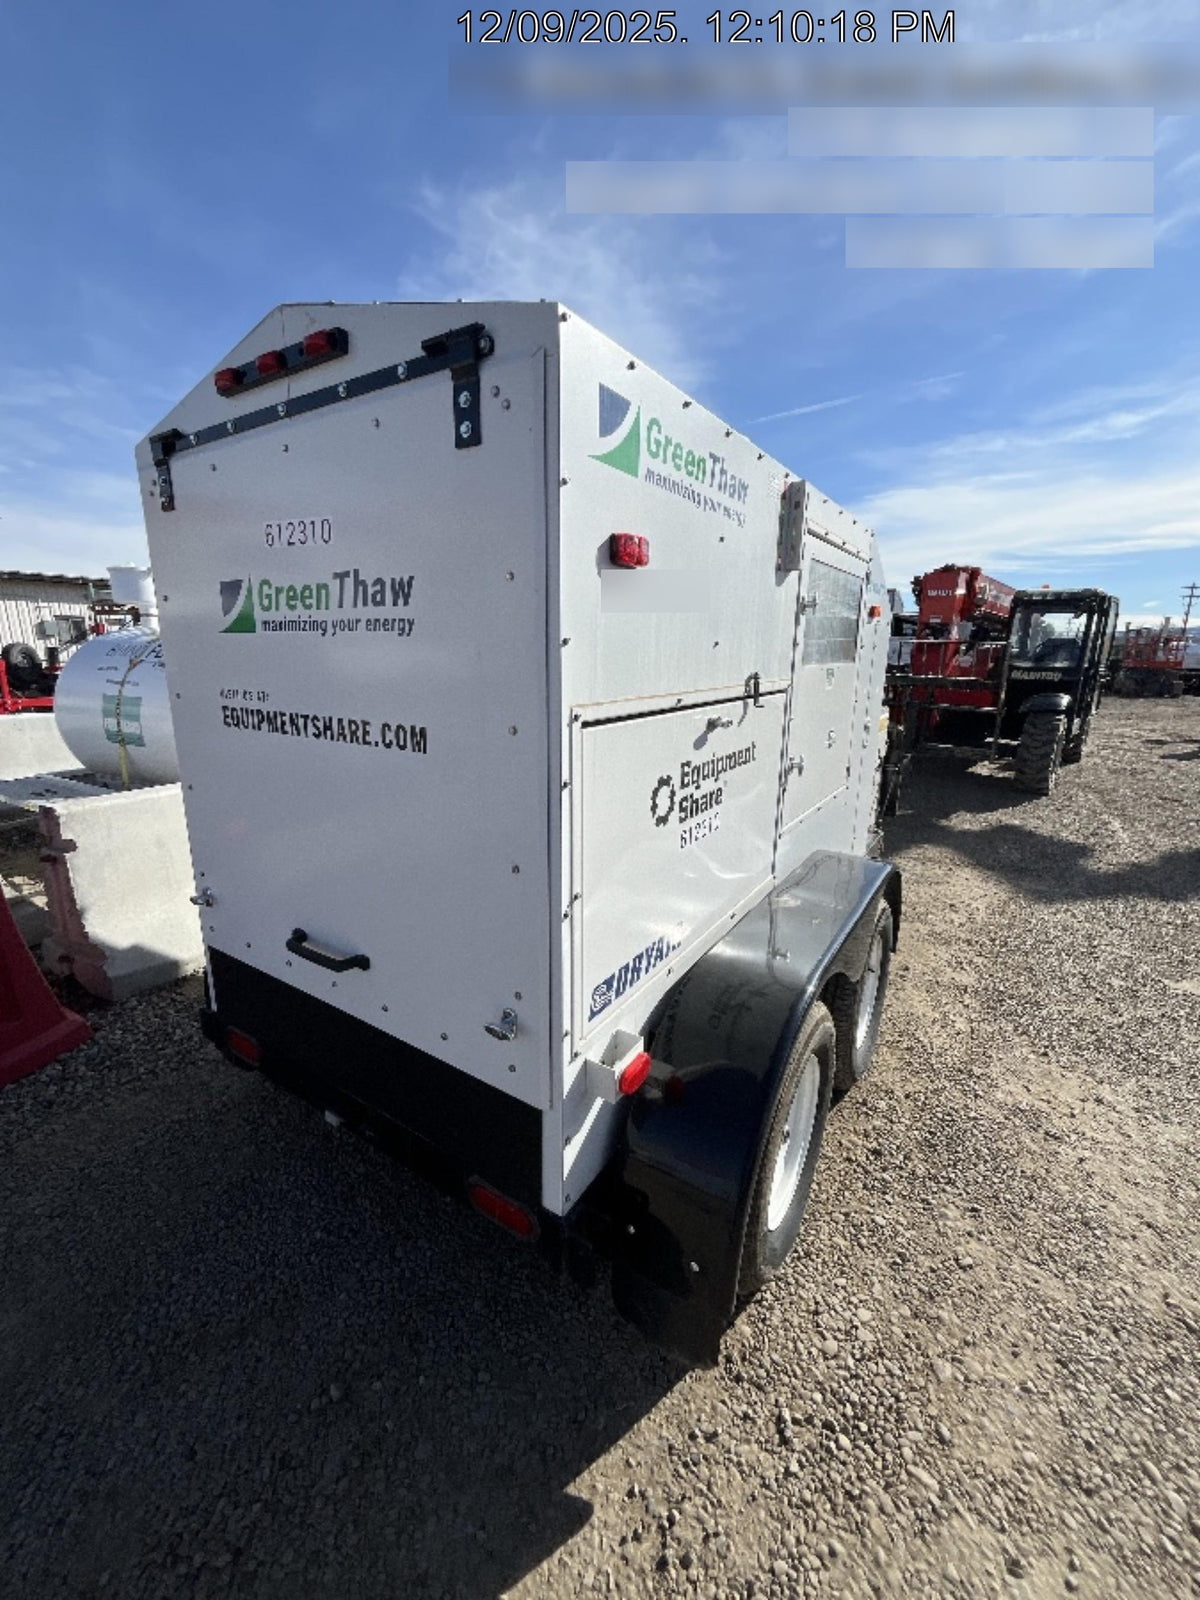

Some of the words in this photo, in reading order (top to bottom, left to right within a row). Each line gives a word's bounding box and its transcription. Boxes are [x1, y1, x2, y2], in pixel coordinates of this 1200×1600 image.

[264, 518, 333, 547] 612310
[261, 615, 328, 637] maximizing
[331, 617, 362, 637] your
[365, 617, 415, 637] energy
[221, 705, 428, 754] EQUIPMENTSHARE.COM
[679, 741, 757, 790] Equipment
[678, 787, 723, 824] Share
